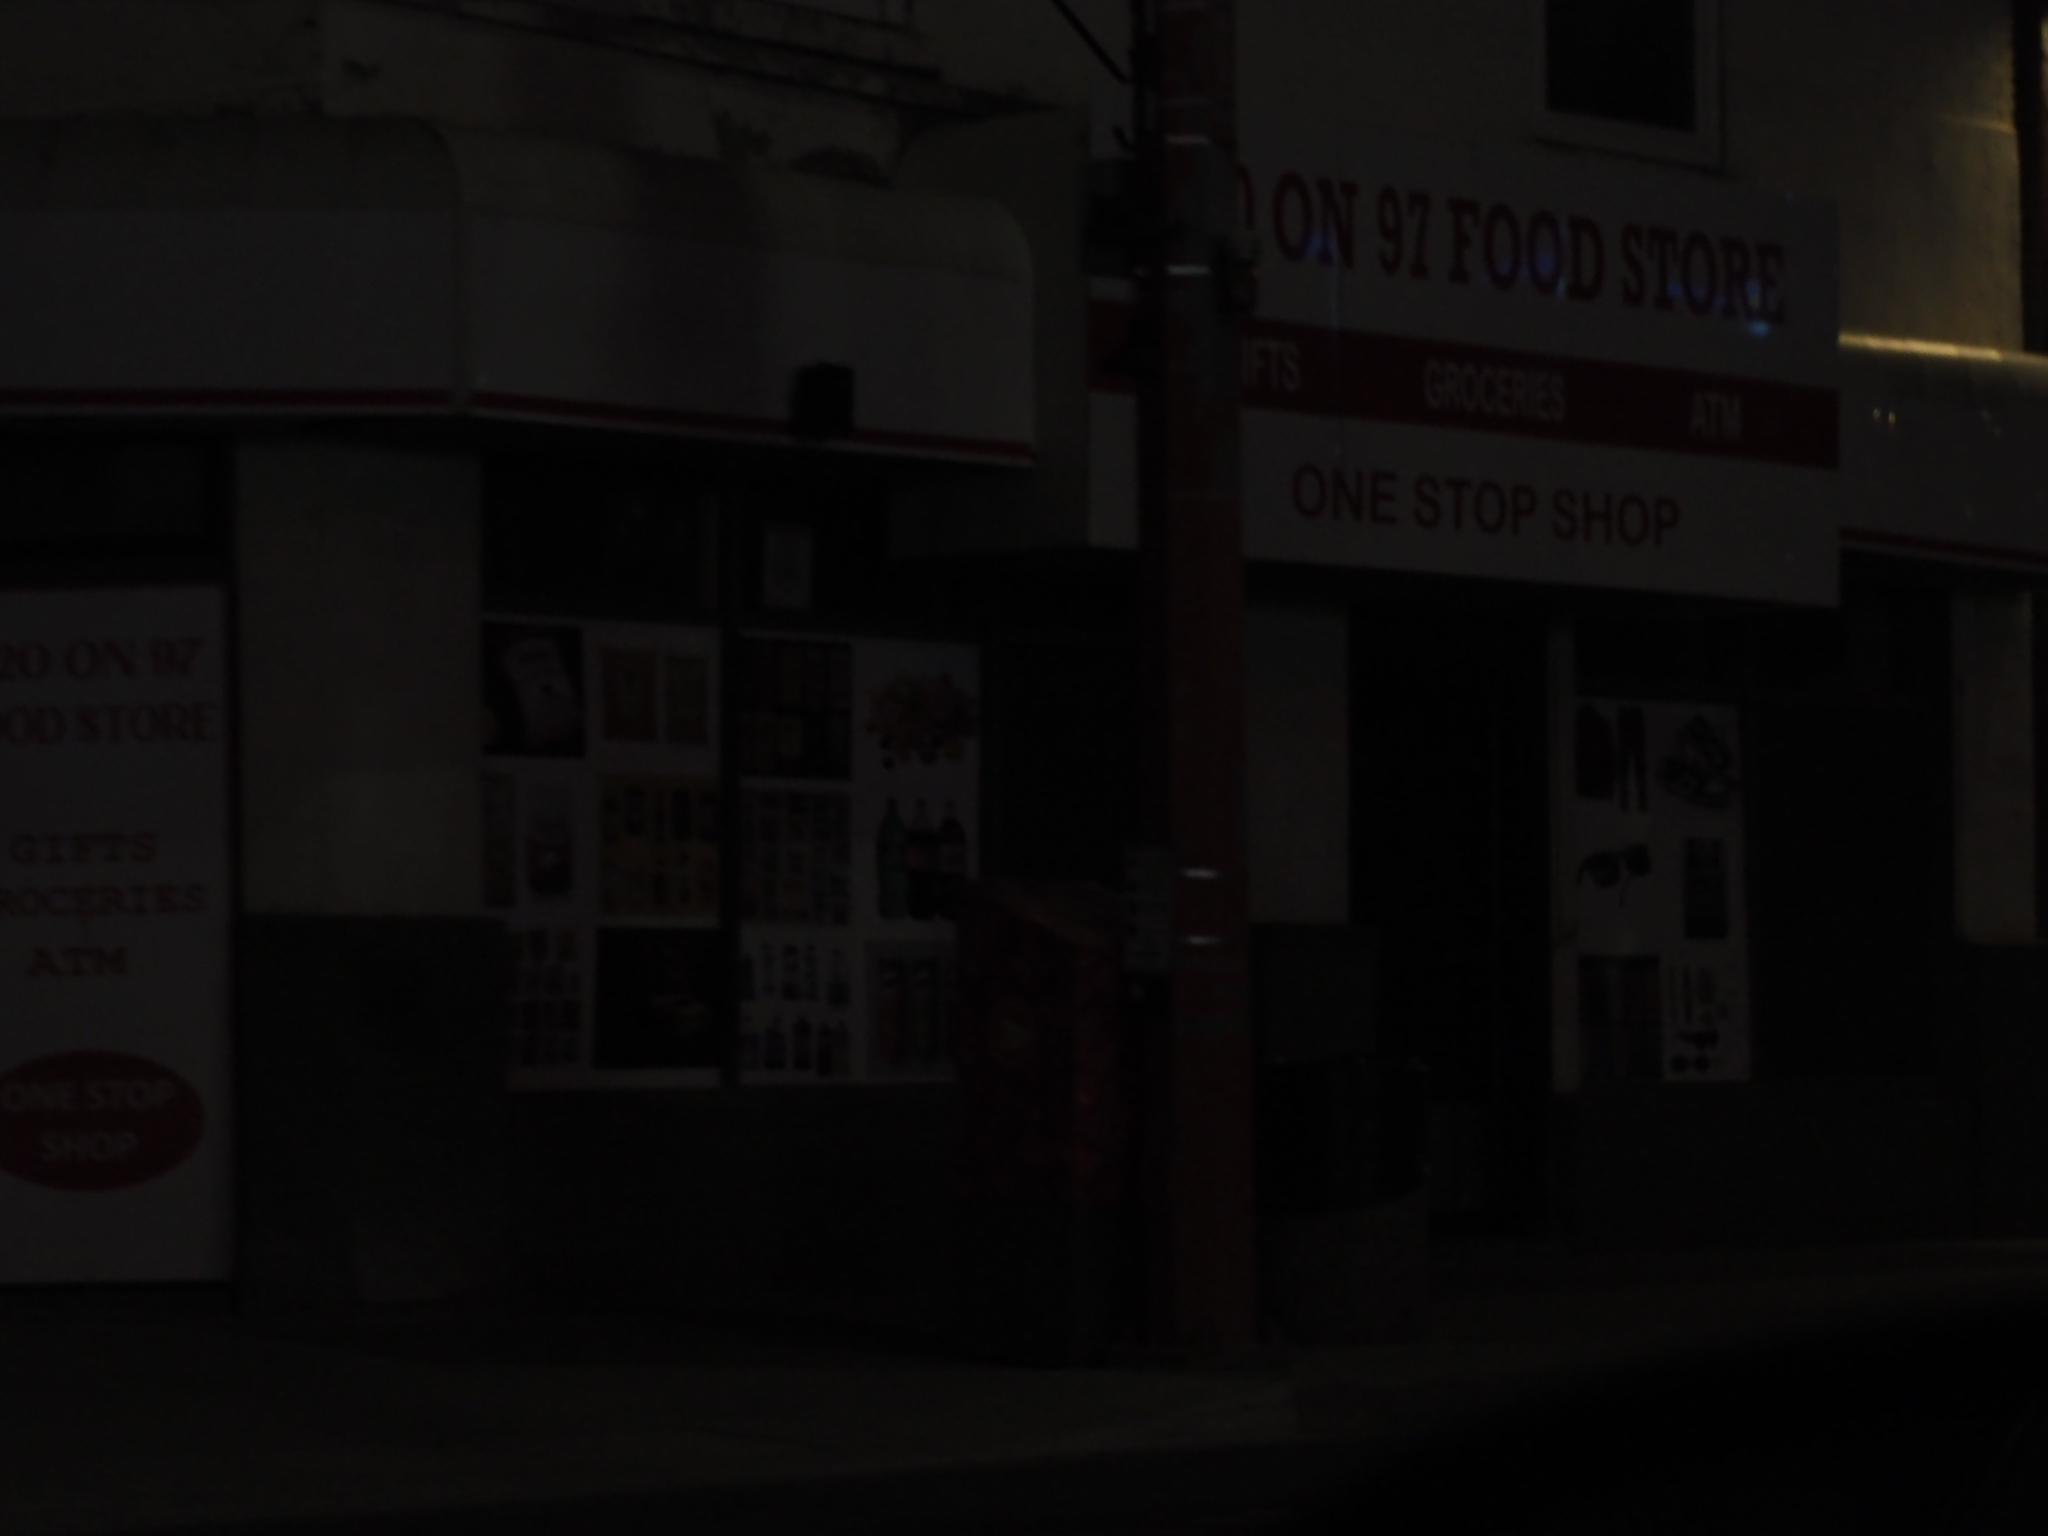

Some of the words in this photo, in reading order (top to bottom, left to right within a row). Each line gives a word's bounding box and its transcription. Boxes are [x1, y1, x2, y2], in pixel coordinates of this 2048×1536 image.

[1272, 169, 1360, 269] ON
[1377, 185, 1430, 281] 97
[1447, 196, 1604, 302] FOOD
[1621, 221, 1785, 325] STORE
[1423, 356, 1567, 423] GROCERIES
[1690, 389, 1742, 440] ATM
[1292, 463, 1397, 525] ONE
[1413, 472, 1538, 535] STOP
[1552, 488, 1680, 548] SHOP
[64, 637, 138, 681] ON
[150, 636, 205, 678] 97
[0, 705, 66, 746] OD
[76, 701, 218, 744] STORE
[8, 831, 158, 865] GIFTS
[26, 946, 129, 977] ATM
[1, 1081, 78, 1113] ONE
[84, 1079, 177, 1111] STOP
[39, 1127, 140, 1164] SHOP
